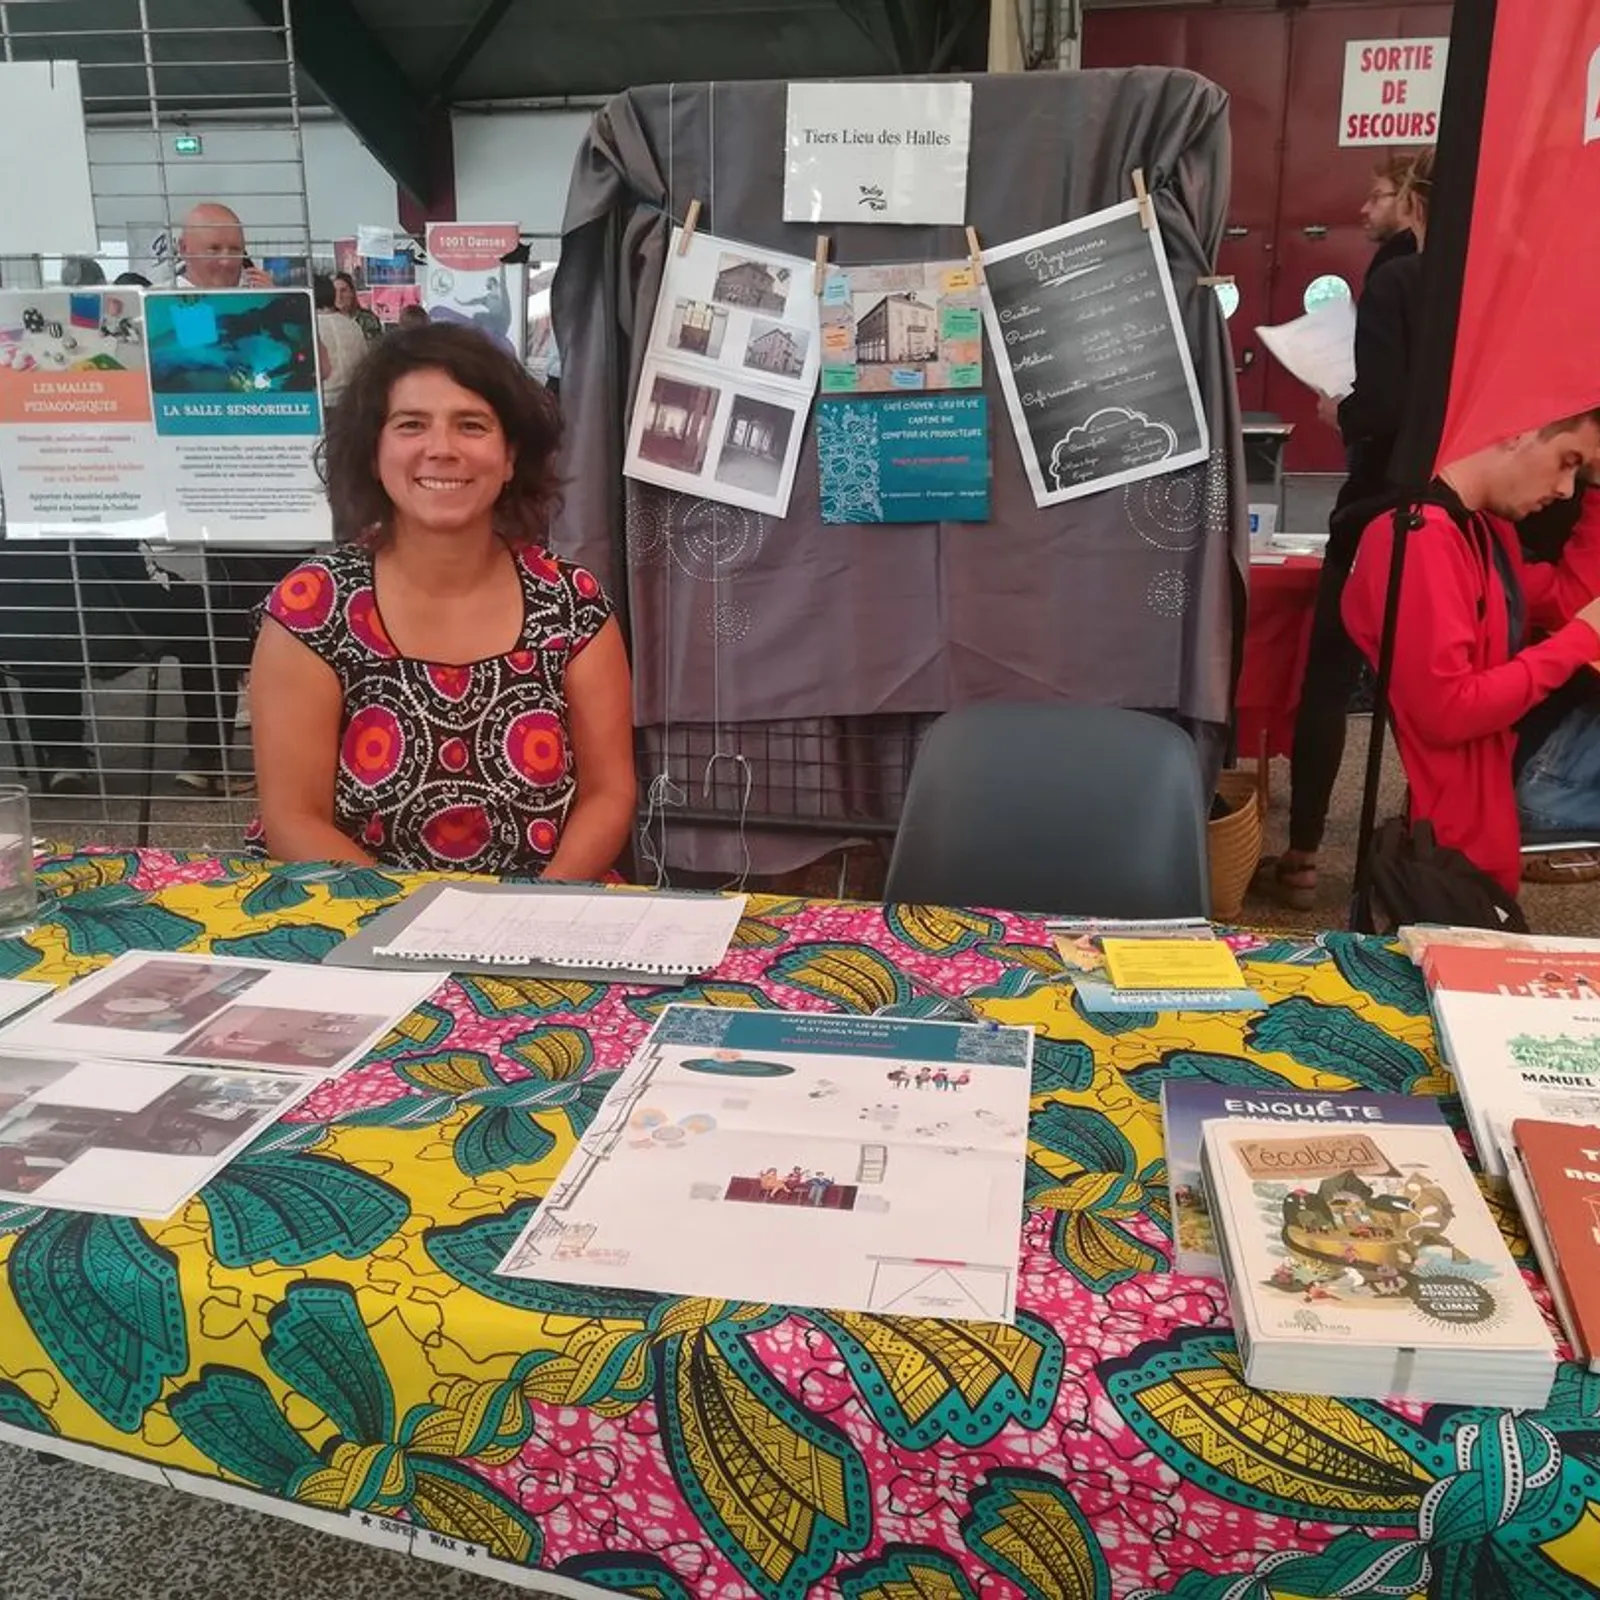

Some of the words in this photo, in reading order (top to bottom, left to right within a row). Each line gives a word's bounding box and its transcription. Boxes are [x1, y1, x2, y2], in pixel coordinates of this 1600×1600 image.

[1361, 45, 1434, 72] SORTIE
[1382, 80, 1407, 105] DE
[1346, 112, 1437, 139] SECOURS
[803, 129, 839, 144] Tiers
[842, 129, 874, 144] Lieu
[878, 129, 902, 144] des
[905, 130, 951, 145] Halles
[440, 236, 463, 247] 1001
[467, 236, 506, 247] Danses
[33, 382, 55, 394] LES
[56, 382, 105, 394] MALLES
[163, 405, 181, 416] LA
[183, 405, 222, 416] SALLE
[226, 404, 311, 416] SENSORIELLE
[1521, 1072, 1596, 1088] MANUEL
[1224, 1098, 1383, 1120] ENQUÊTE
[1419, 1283, 1467, 1291] ASTUCES
[1430, 1302, 1479, 1311] CLIMAT
[380, 1520, 419, 1539] SUPER
[429, 1532, 458, 1551] WAX
